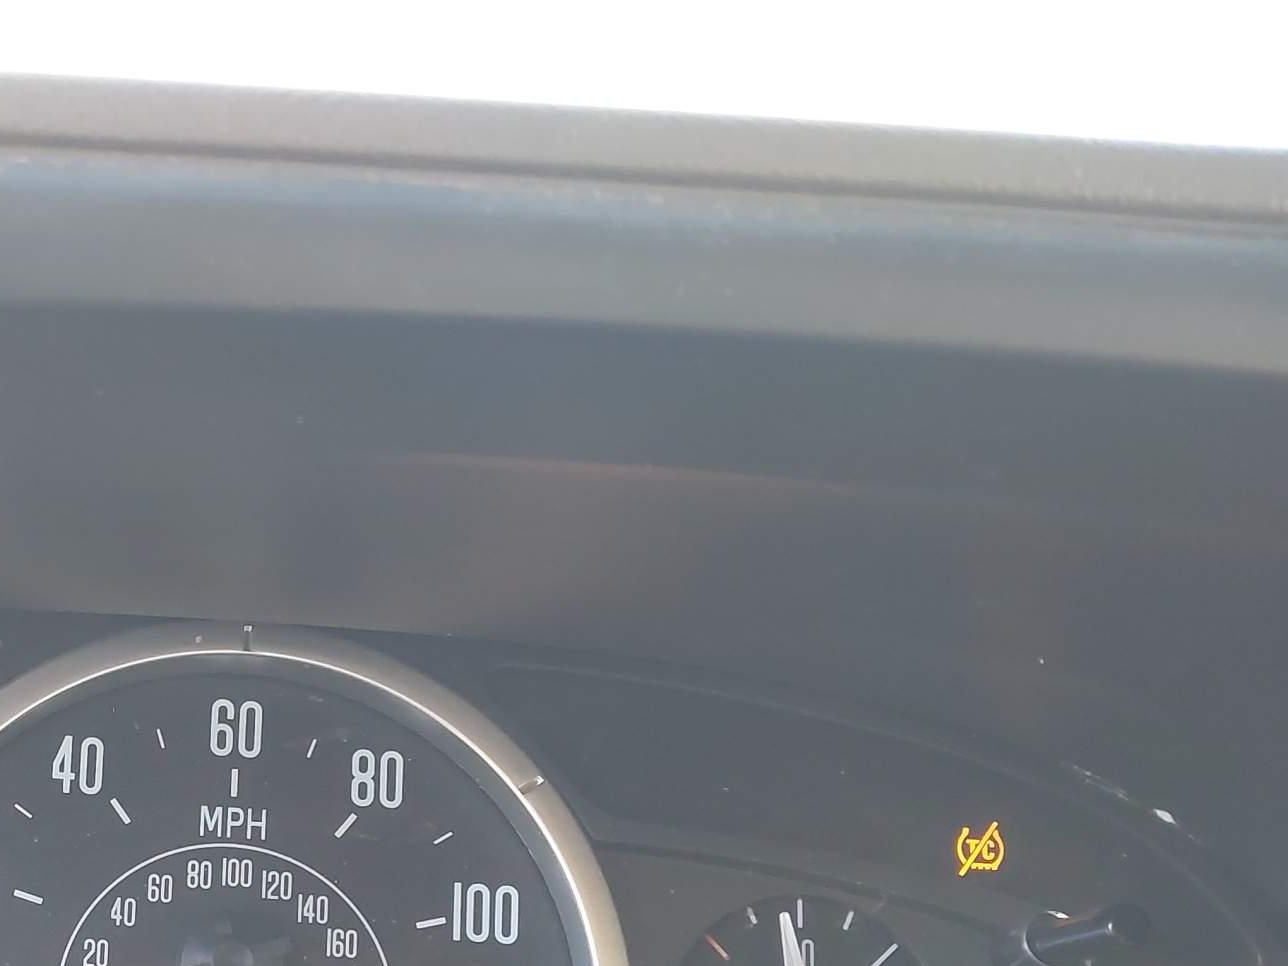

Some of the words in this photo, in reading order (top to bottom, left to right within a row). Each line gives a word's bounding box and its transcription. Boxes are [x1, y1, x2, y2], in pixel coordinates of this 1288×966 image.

[209, 700, 263, 758] 60
[52, 736, 104, 795] 40
[351, 750, 404, 808] 80
[199, 806, 268, 841] MPH
[186, 860, 212, 888] 80
[221, 859, 253, 887] 100
[261, 871, 293, 900] 120
[147, 874, 173, 903] 60
[110, 897, 137, 926] 40
[296, 894, 329, 923] 140
[452, 882, 520, 944] 100
[326, 929, 358, 959] 160
